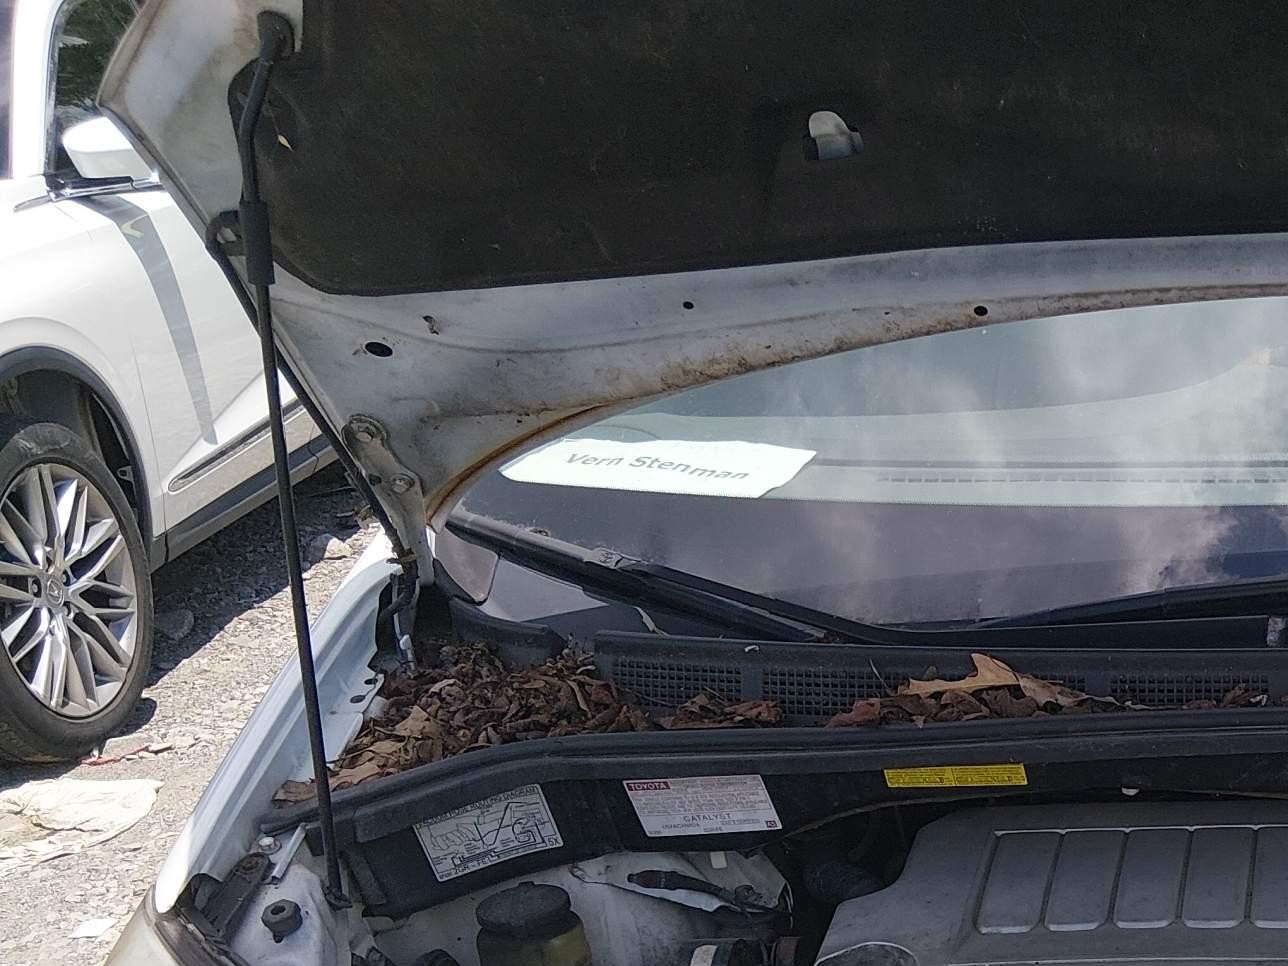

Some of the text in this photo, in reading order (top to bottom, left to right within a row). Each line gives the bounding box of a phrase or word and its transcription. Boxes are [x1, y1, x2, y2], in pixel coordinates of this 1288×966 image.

[567, 452, 750, 480] Vern Stenman
[629, 782, 668, 792] TOYOTA
[683, 812, 731, 823] CATALYST
